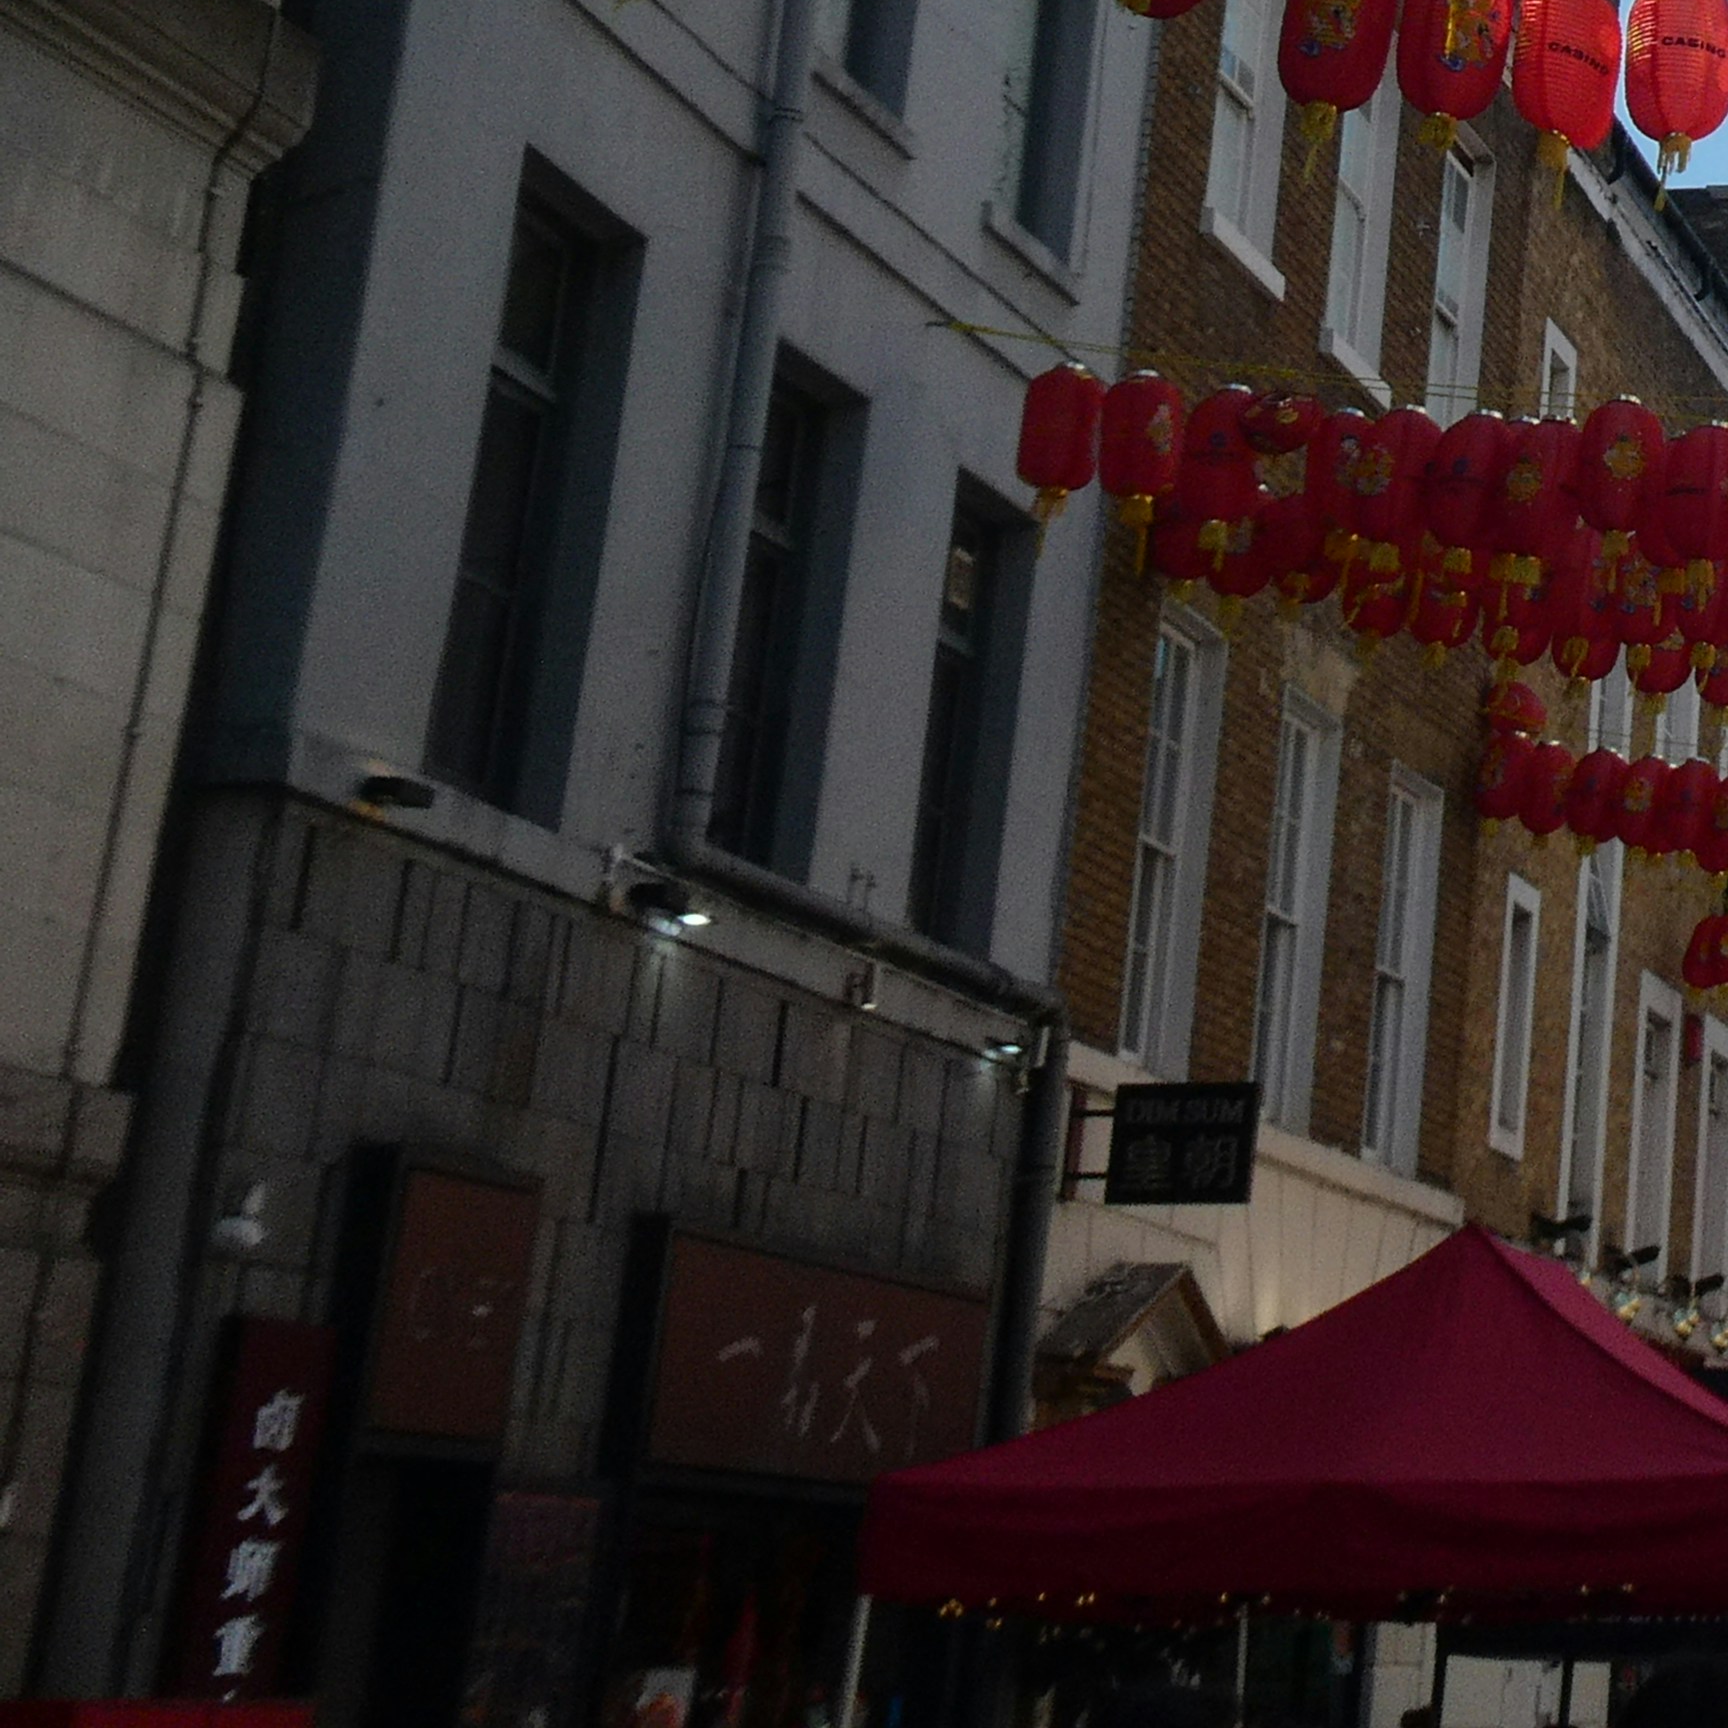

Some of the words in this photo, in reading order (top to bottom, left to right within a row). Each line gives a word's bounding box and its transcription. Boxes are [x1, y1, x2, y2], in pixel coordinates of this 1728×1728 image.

[1548, 41, 1610, 76] CASINO
[1661, 35, 1727, 59] CASINO
[1124, 1098, 1178, 1124] DIM
[1184, 1098, 1246, 1124] SUM
